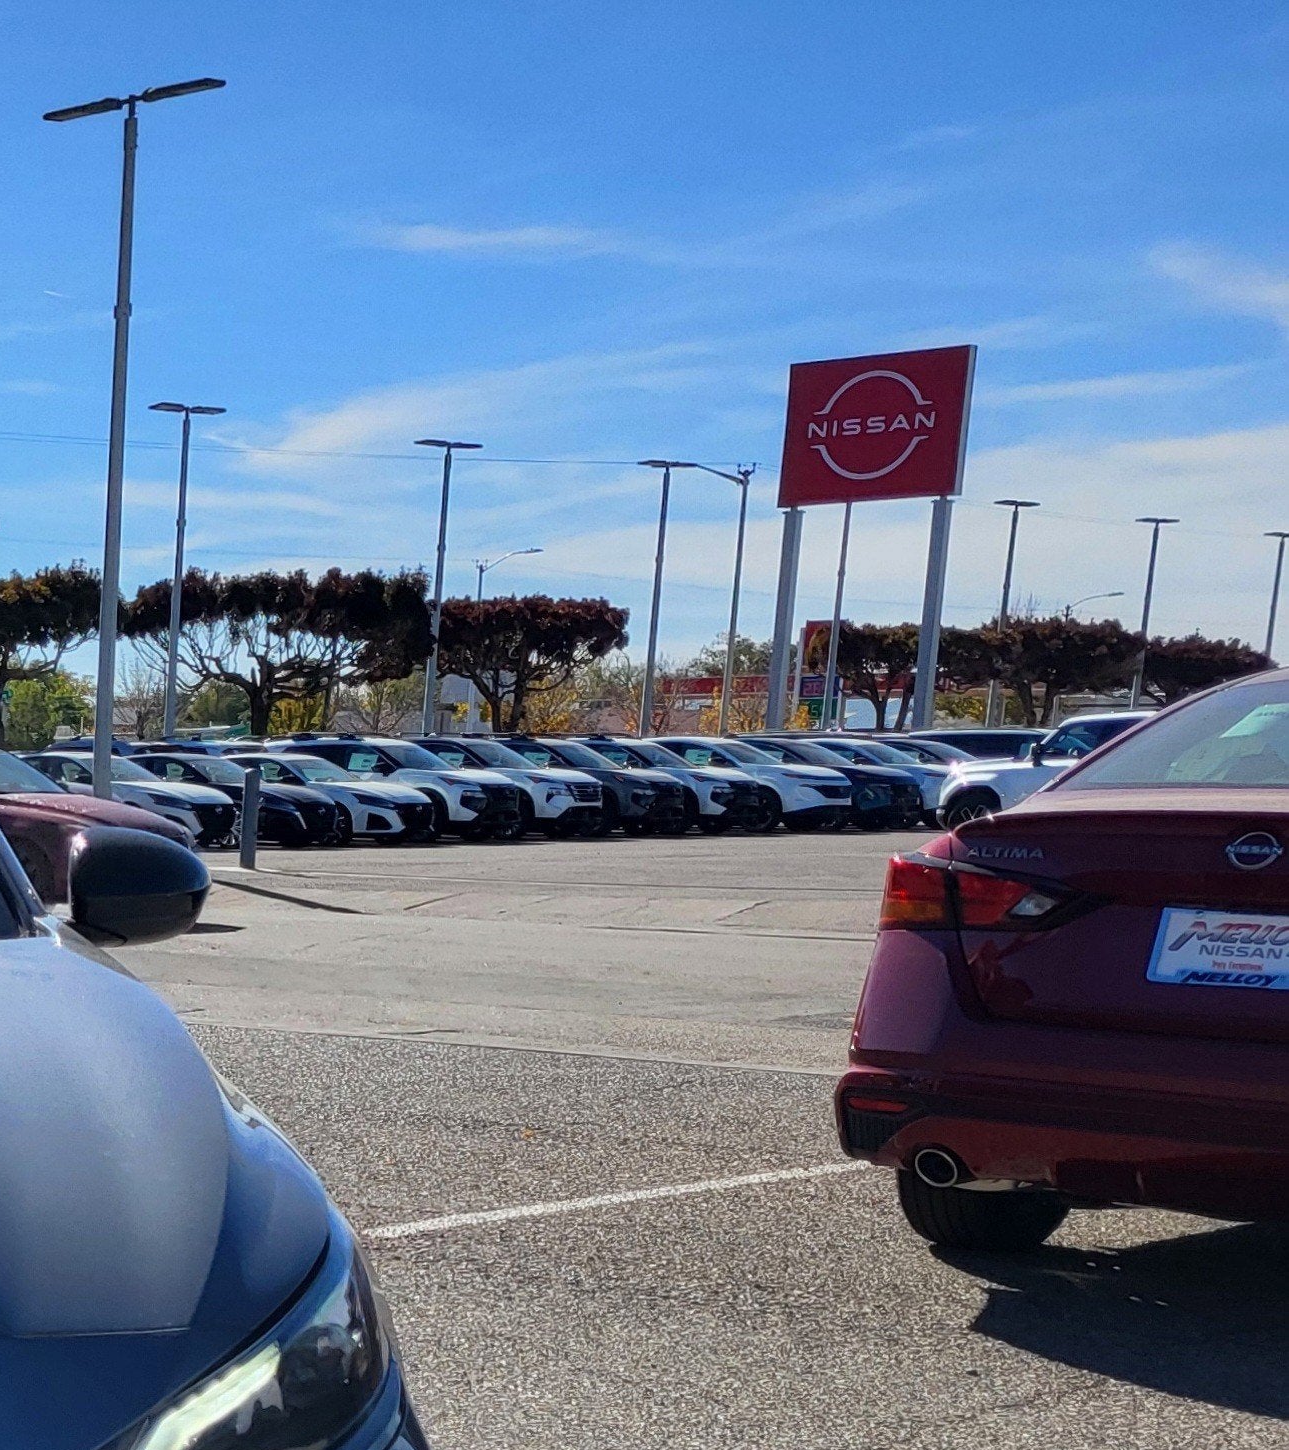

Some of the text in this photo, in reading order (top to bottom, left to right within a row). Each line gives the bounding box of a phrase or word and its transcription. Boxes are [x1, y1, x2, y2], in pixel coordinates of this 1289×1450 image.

[807, 411, 936, 439] NISSAN
[966, 846, 1045, 859] ALTIMA
[1225, 844, 1284, 856] NISSAN
[1168, 920, 1289, 952] MELLO
[1198, 944, 1284, 960] NISSAN
[1181, 971, 1280, 987] MELLOY
